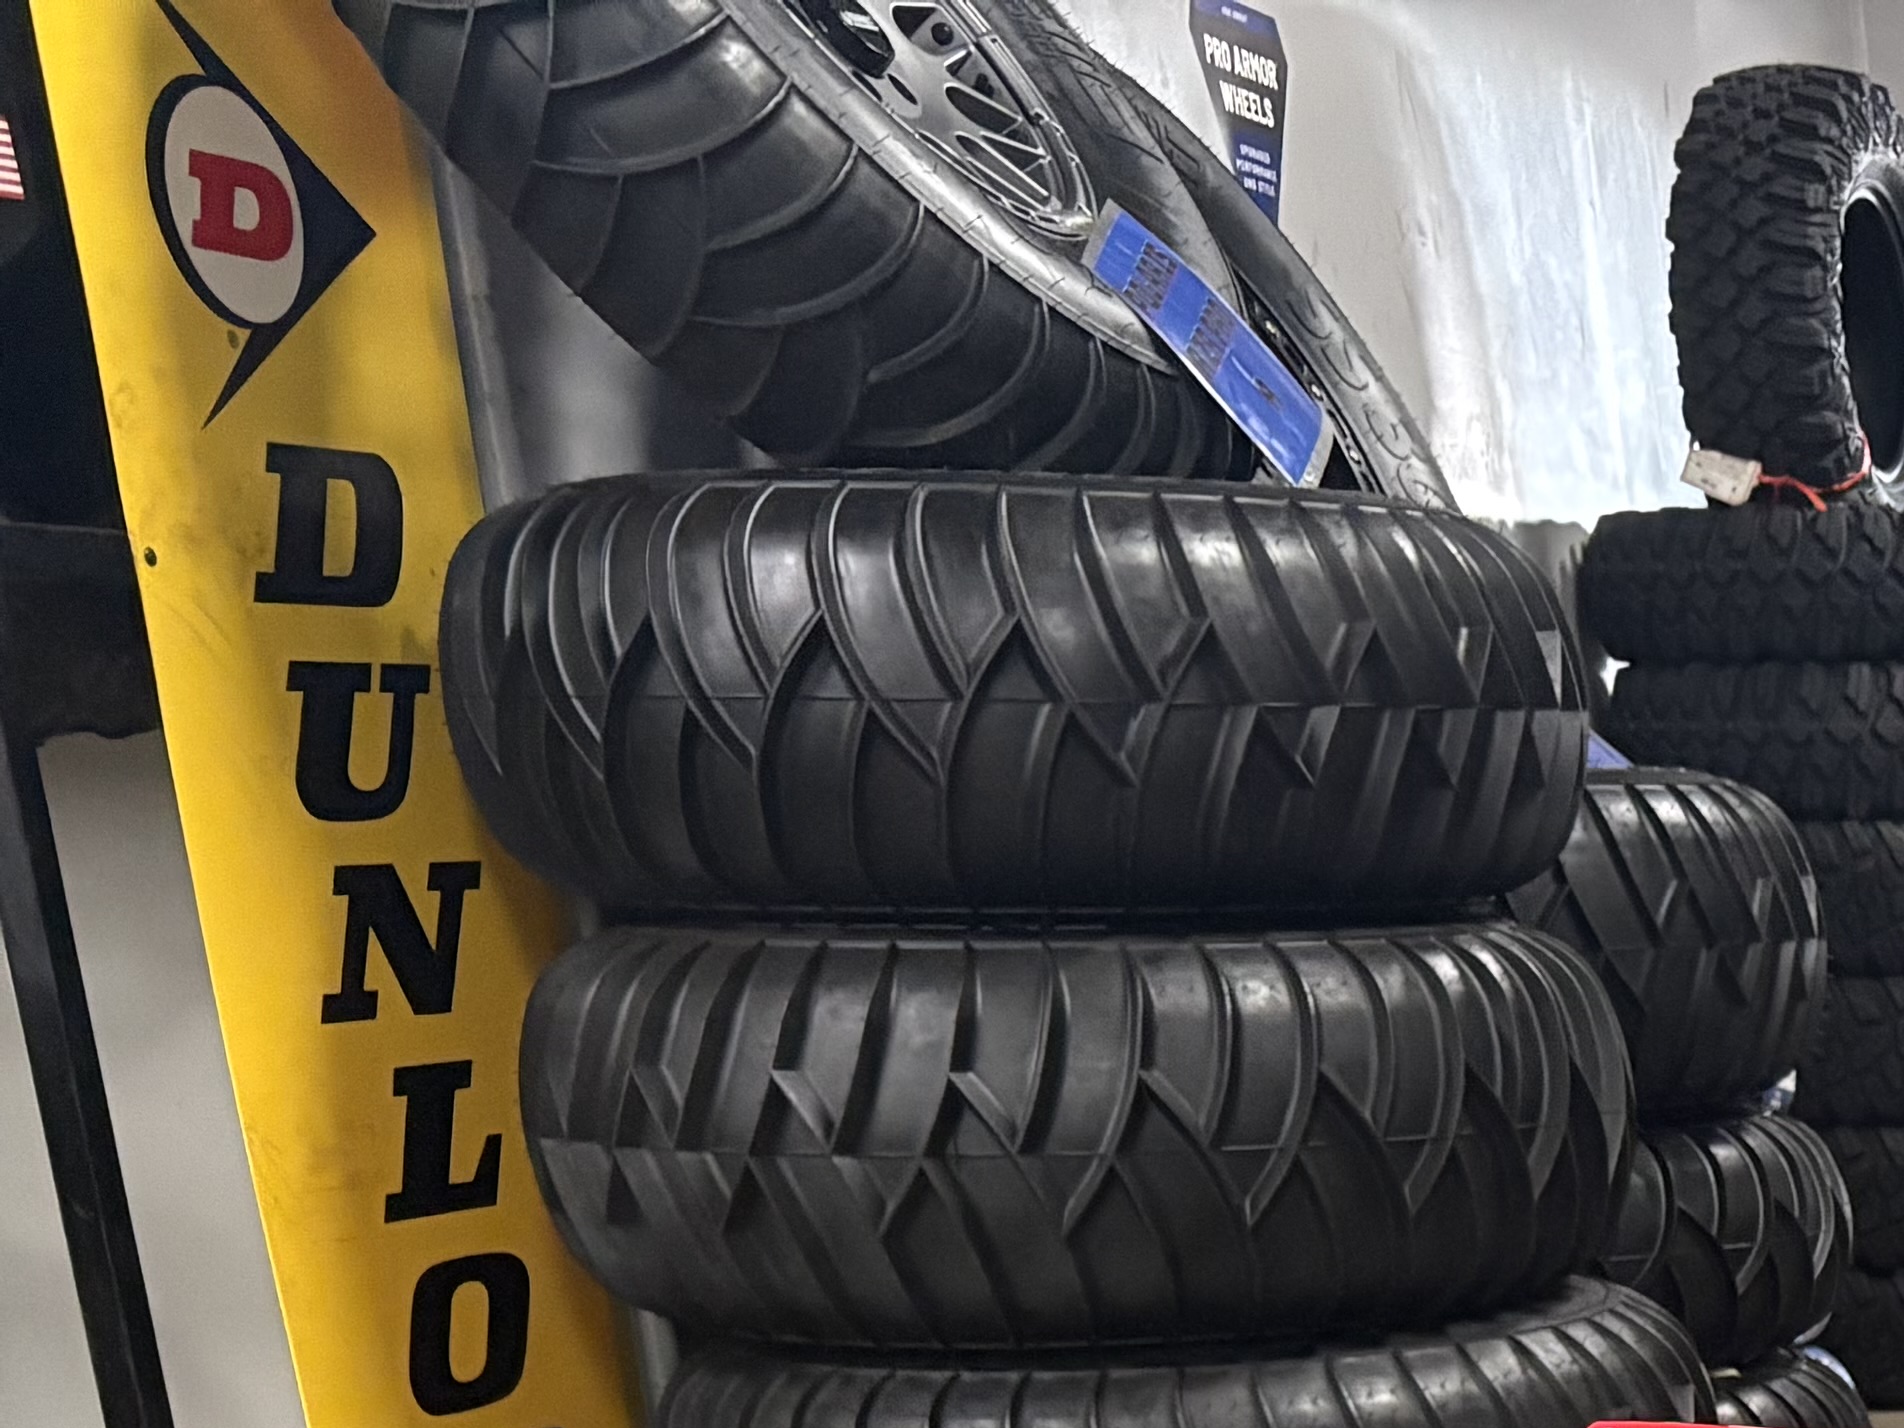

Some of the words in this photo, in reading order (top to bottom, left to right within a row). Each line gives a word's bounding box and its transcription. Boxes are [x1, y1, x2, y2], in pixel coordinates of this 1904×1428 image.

[1203, 33, 1232, 73] PRO
[1233, 45, 1279, 91] ARMOR
[1219, 80, 1275, 129] WHEELS
[188, 148, 295, 262] D
